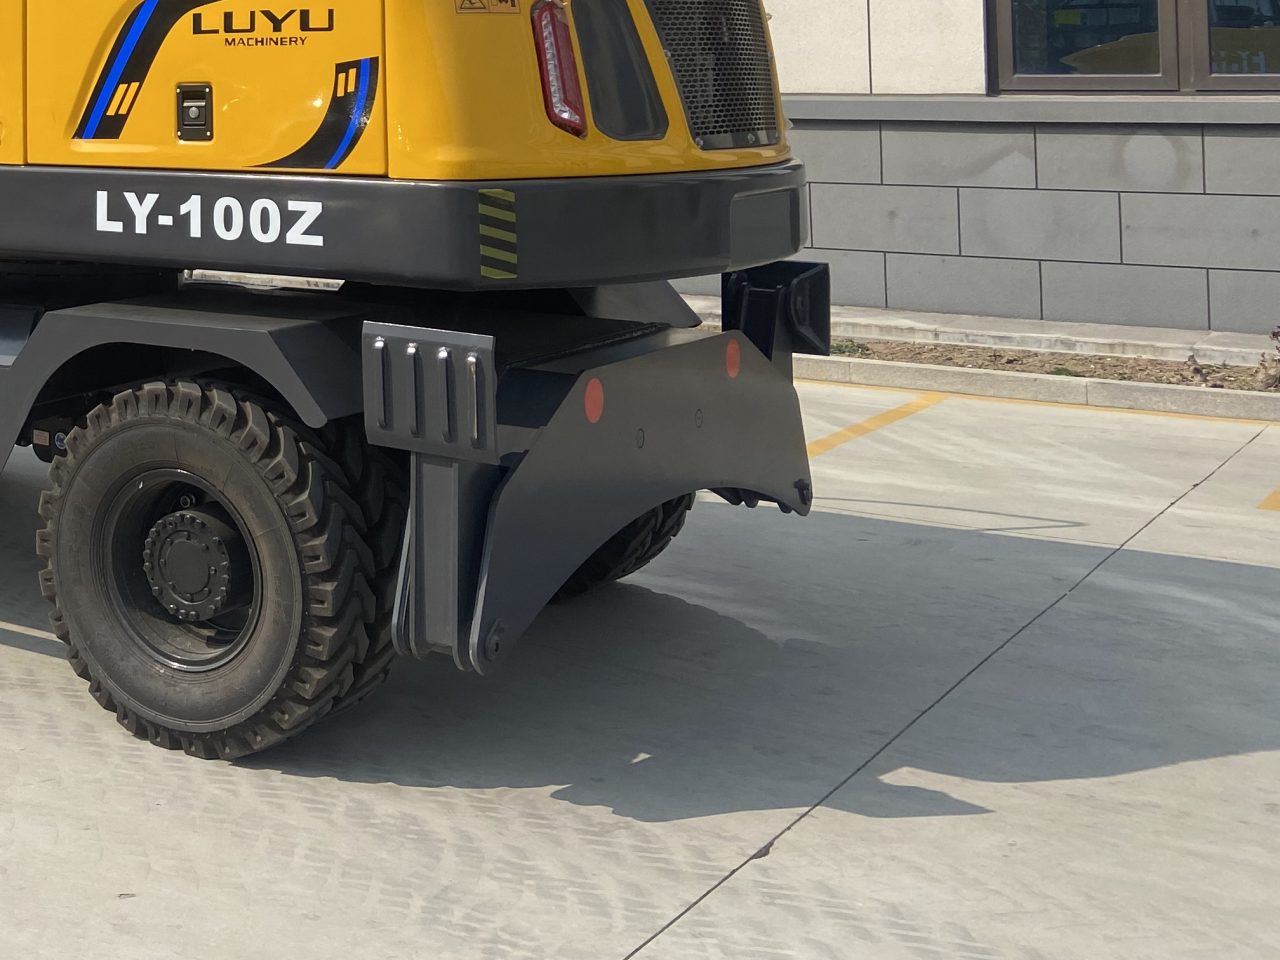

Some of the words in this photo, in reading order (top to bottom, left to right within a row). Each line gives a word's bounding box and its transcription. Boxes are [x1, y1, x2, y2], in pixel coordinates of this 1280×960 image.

[192, 8, 334, 35] LUYU
[224, 36, 308, 47] MACHINERY
[96, 190, 324, 247] LY-100Z
